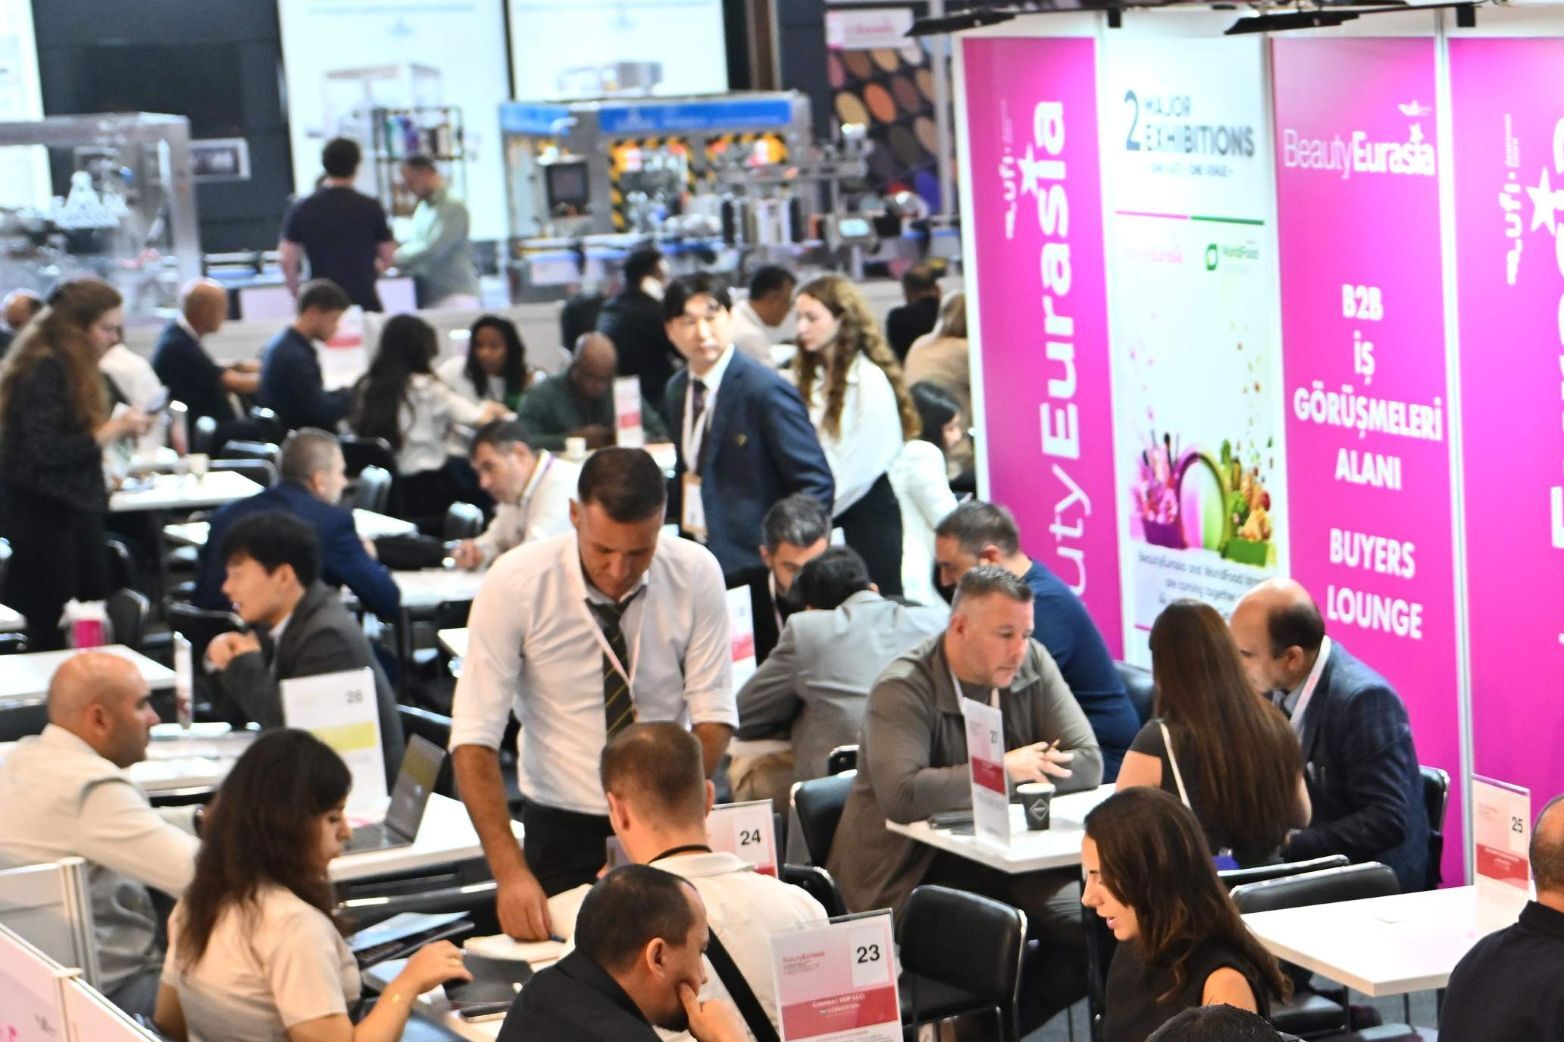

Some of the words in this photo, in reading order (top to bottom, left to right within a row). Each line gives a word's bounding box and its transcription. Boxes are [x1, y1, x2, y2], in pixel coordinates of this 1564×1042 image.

[1125, 90, 1140, 151] 2
[1283, 124, 1435, 180] BeautyEurasia
[1342, 283, 1384, 321] B2B
[1026, 101, 1090, 597] utyEurasia
[1354, 330, 1375, 385] İŞ
[1294, 380, 1443, 441] GÖRÜŞMELERİ
[1335, 448, 1402, 490] ALANI
[1329, 528, 1415, 579] BUYERS
[1327, 585, 1423, 640] LOUNGE
[740, 828, 761, 847] 24
[1511, 816, 1524, 834] 25
[856, 944, 881, 964] 23
